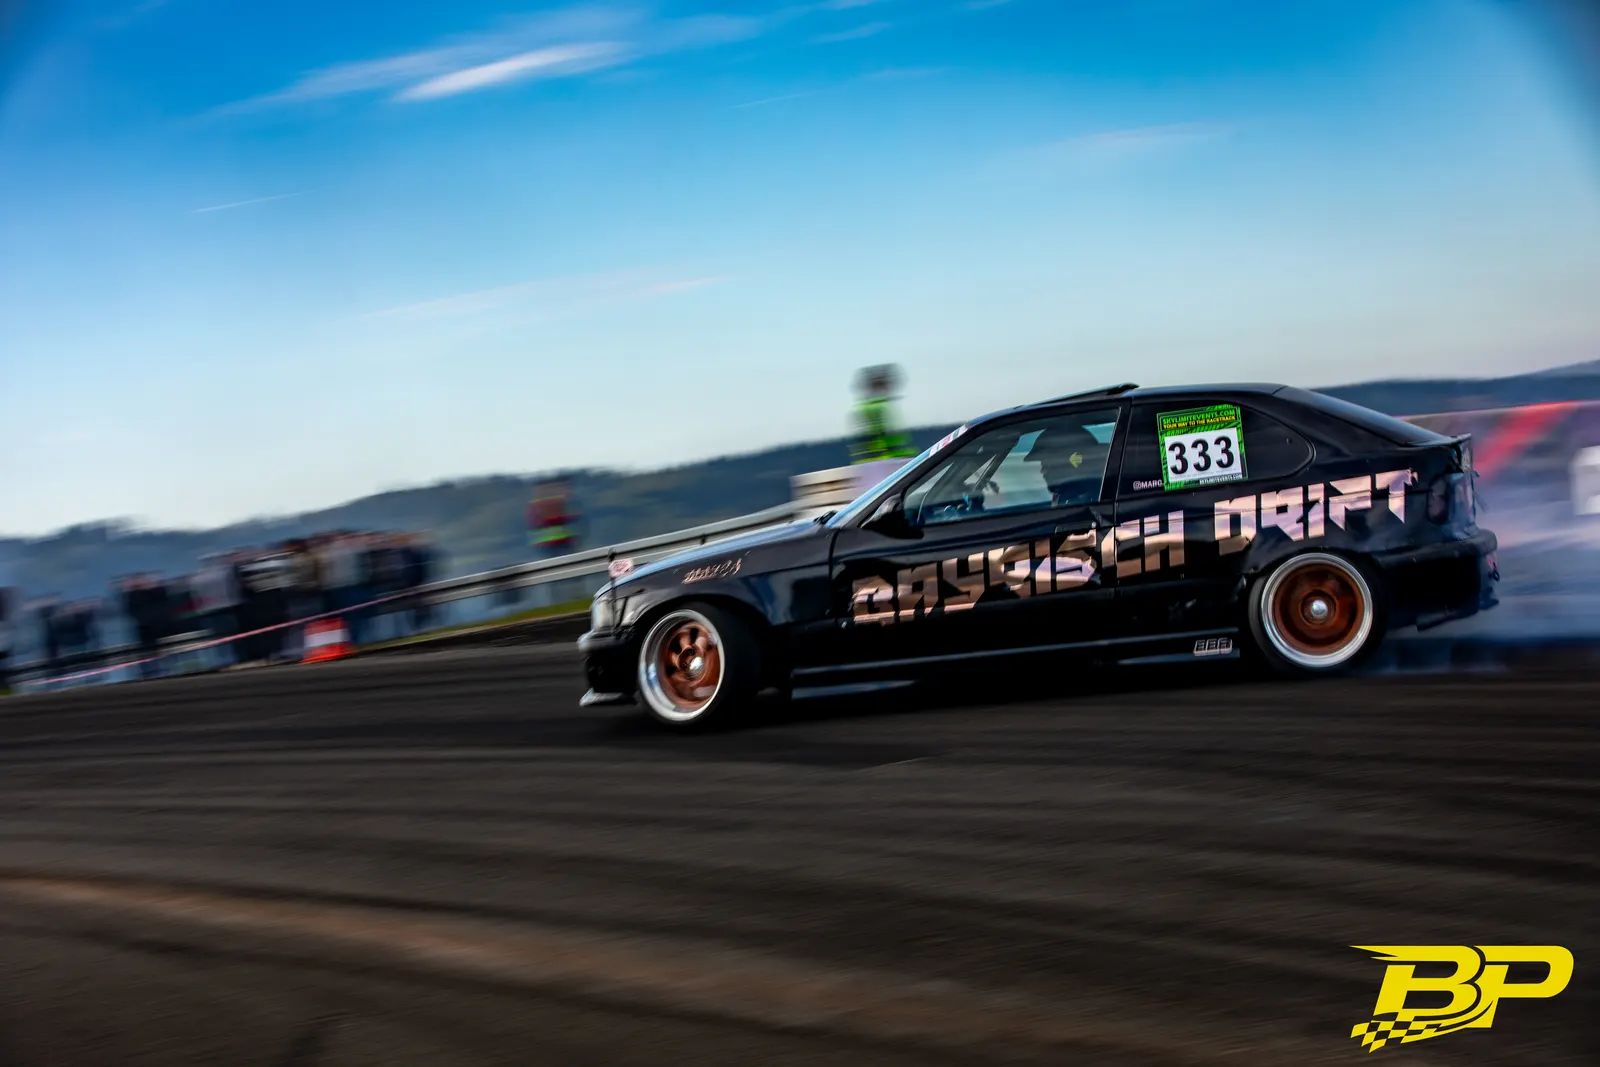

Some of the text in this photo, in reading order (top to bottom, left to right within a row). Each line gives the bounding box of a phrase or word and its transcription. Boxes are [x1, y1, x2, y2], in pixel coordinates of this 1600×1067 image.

[1163, 409, 1235, 424] SKYLIMITEVENTS.COM
[1206, 416, 1236, 425] RACETRACK
[1168, 435, 1235, 475] 333
[852, 468, 1418, 627] BAYRISCH DRIFT
